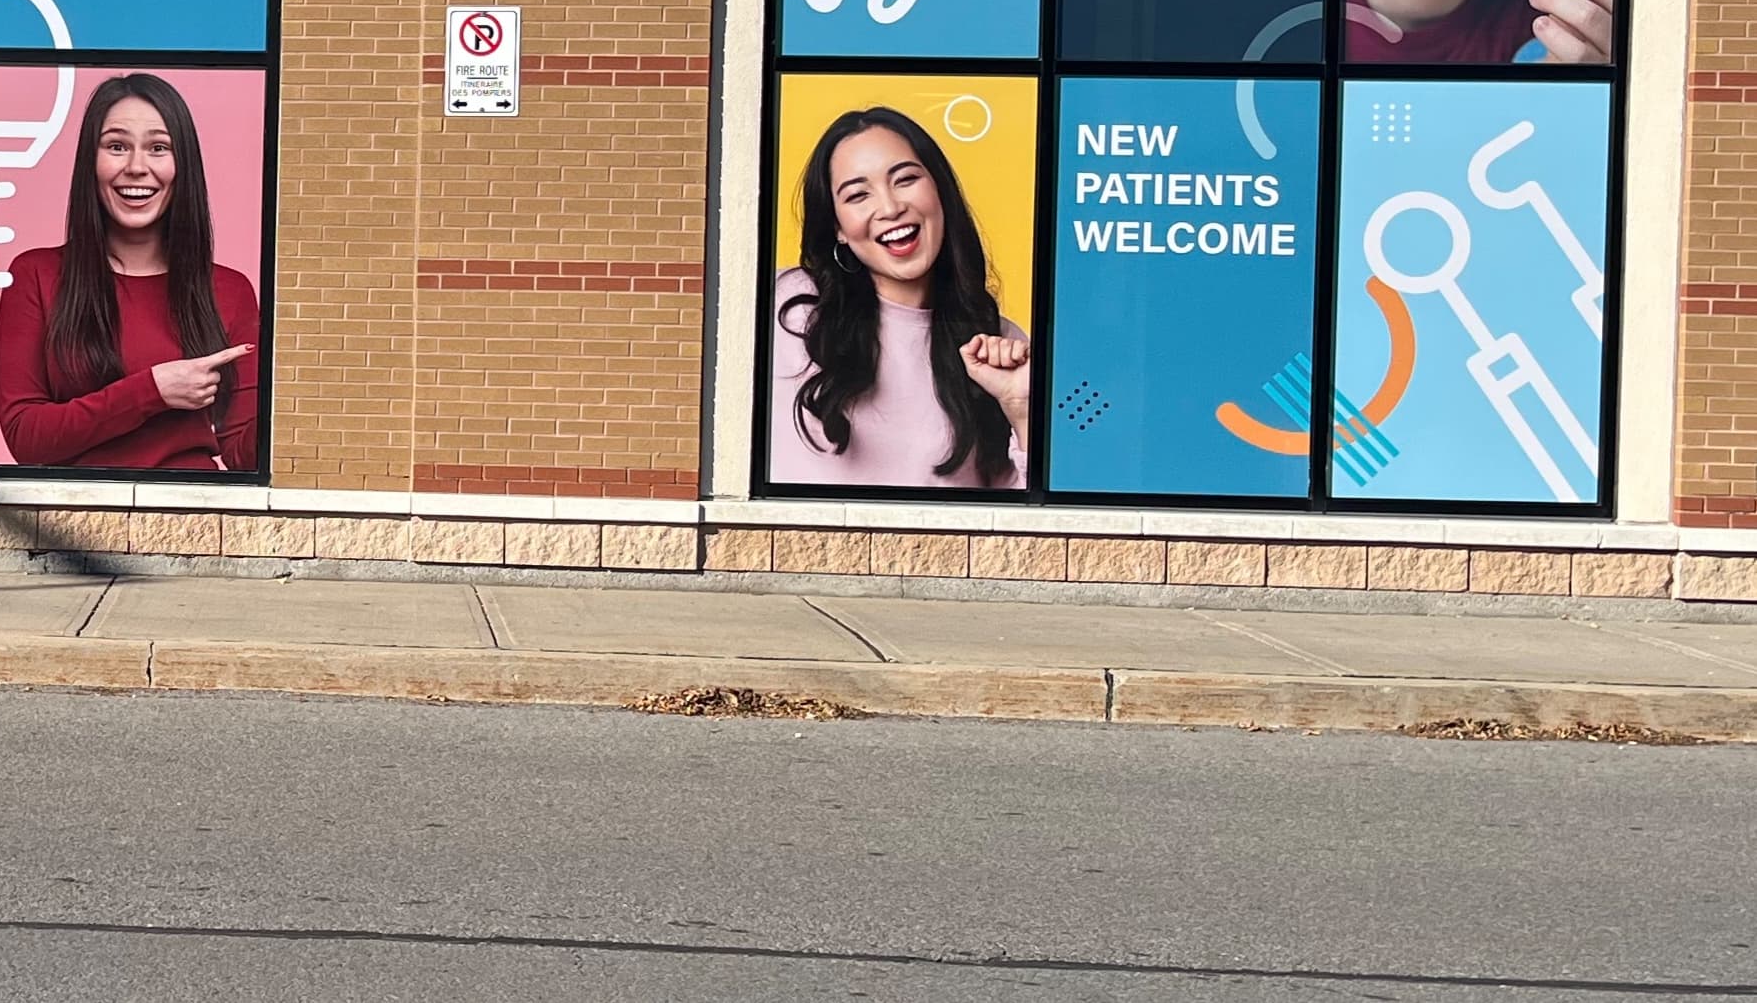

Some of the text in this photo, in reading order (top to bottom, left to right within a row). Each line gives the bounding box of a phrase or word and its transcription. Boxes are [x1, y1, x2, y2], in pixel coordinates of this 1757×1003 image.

[456, 65, 509, 76] FIRE ROUTE
[1077, 124, 1179, 157] NEW
[1075, 172, 1280, 207] PATIENTS
[1073, 220, 1296, 256] WELCOME
